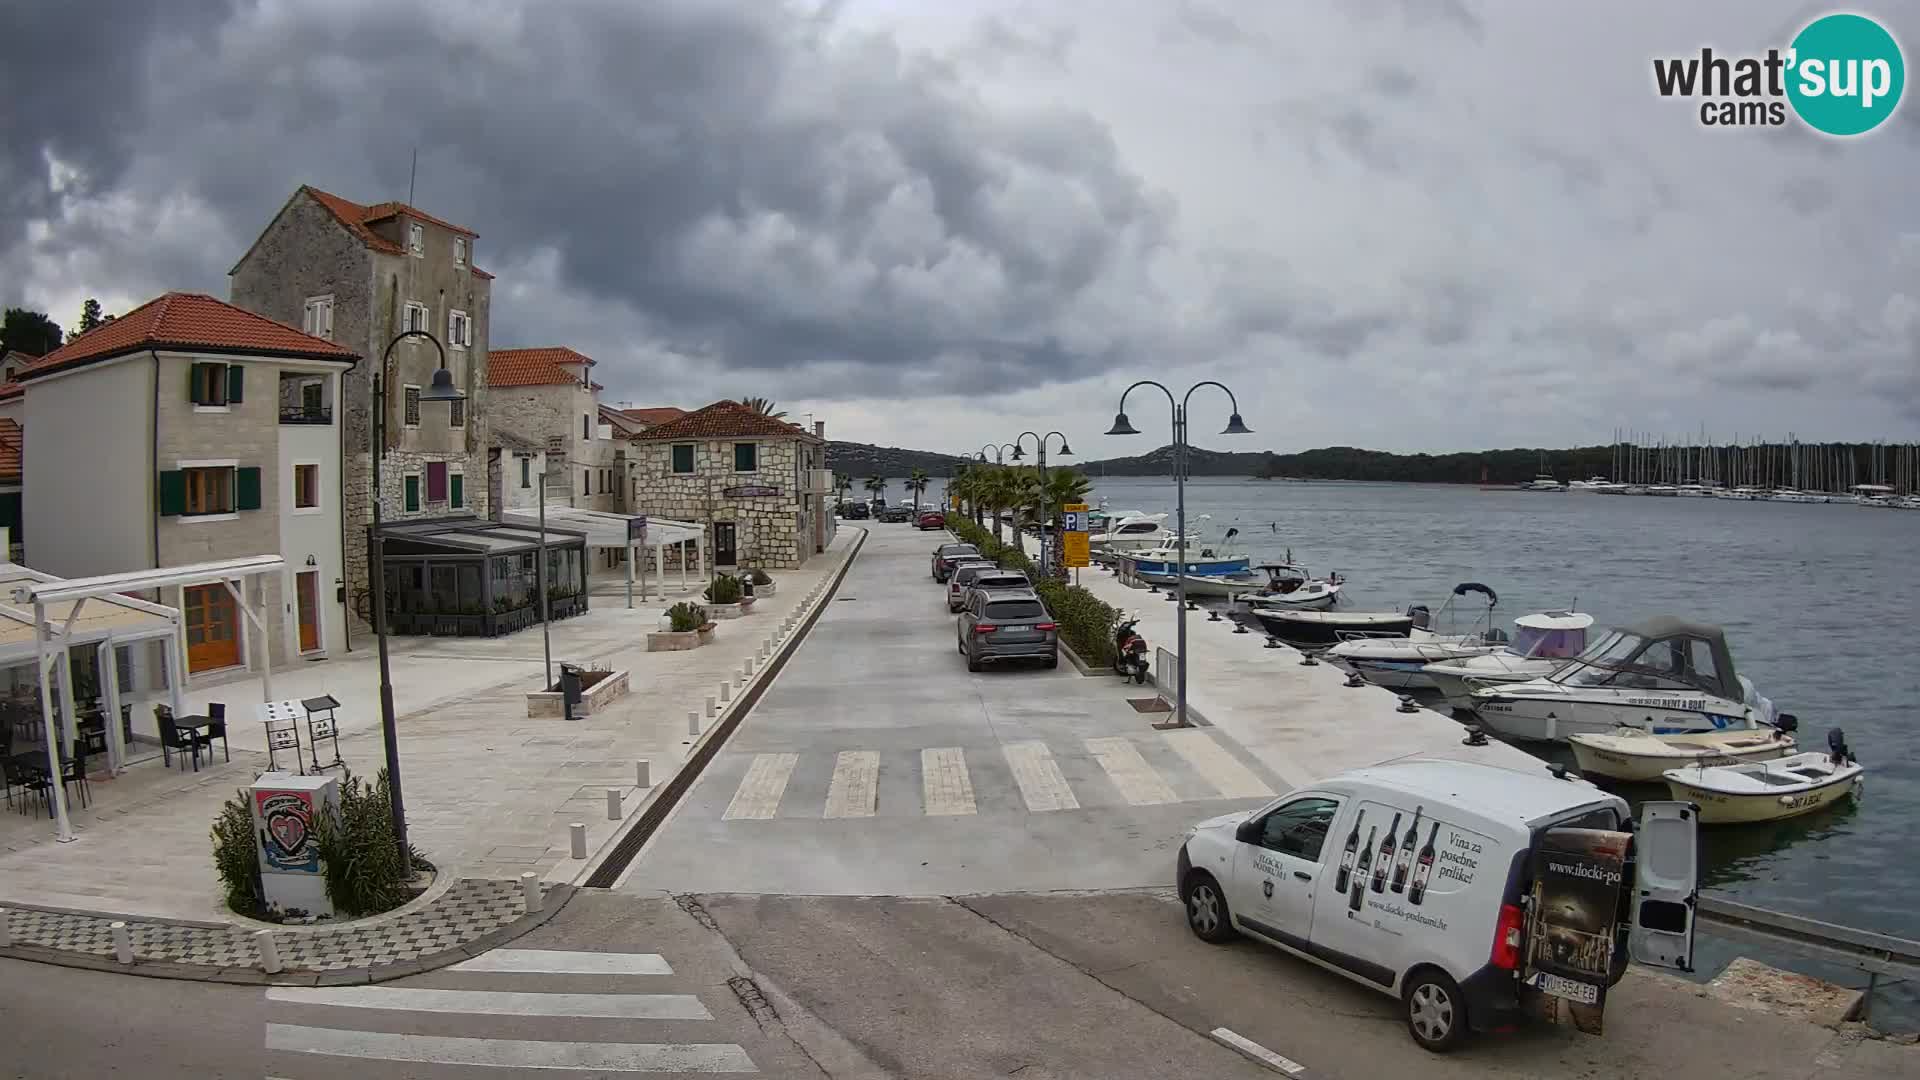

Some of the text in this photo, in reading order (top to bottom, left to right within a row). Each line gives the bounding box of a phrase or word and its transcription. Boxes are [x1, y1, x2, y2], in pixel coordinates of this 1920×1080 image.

[1066, 514, 1076, 529] P
[1450, 832, 1482, 853] Vina za
[1439, 850, 1477, 868] posebne
[1438, 866, 1473, 884] prilike!
[1368, 900, 1448, 930] www.ilocki-podrumi.hr
